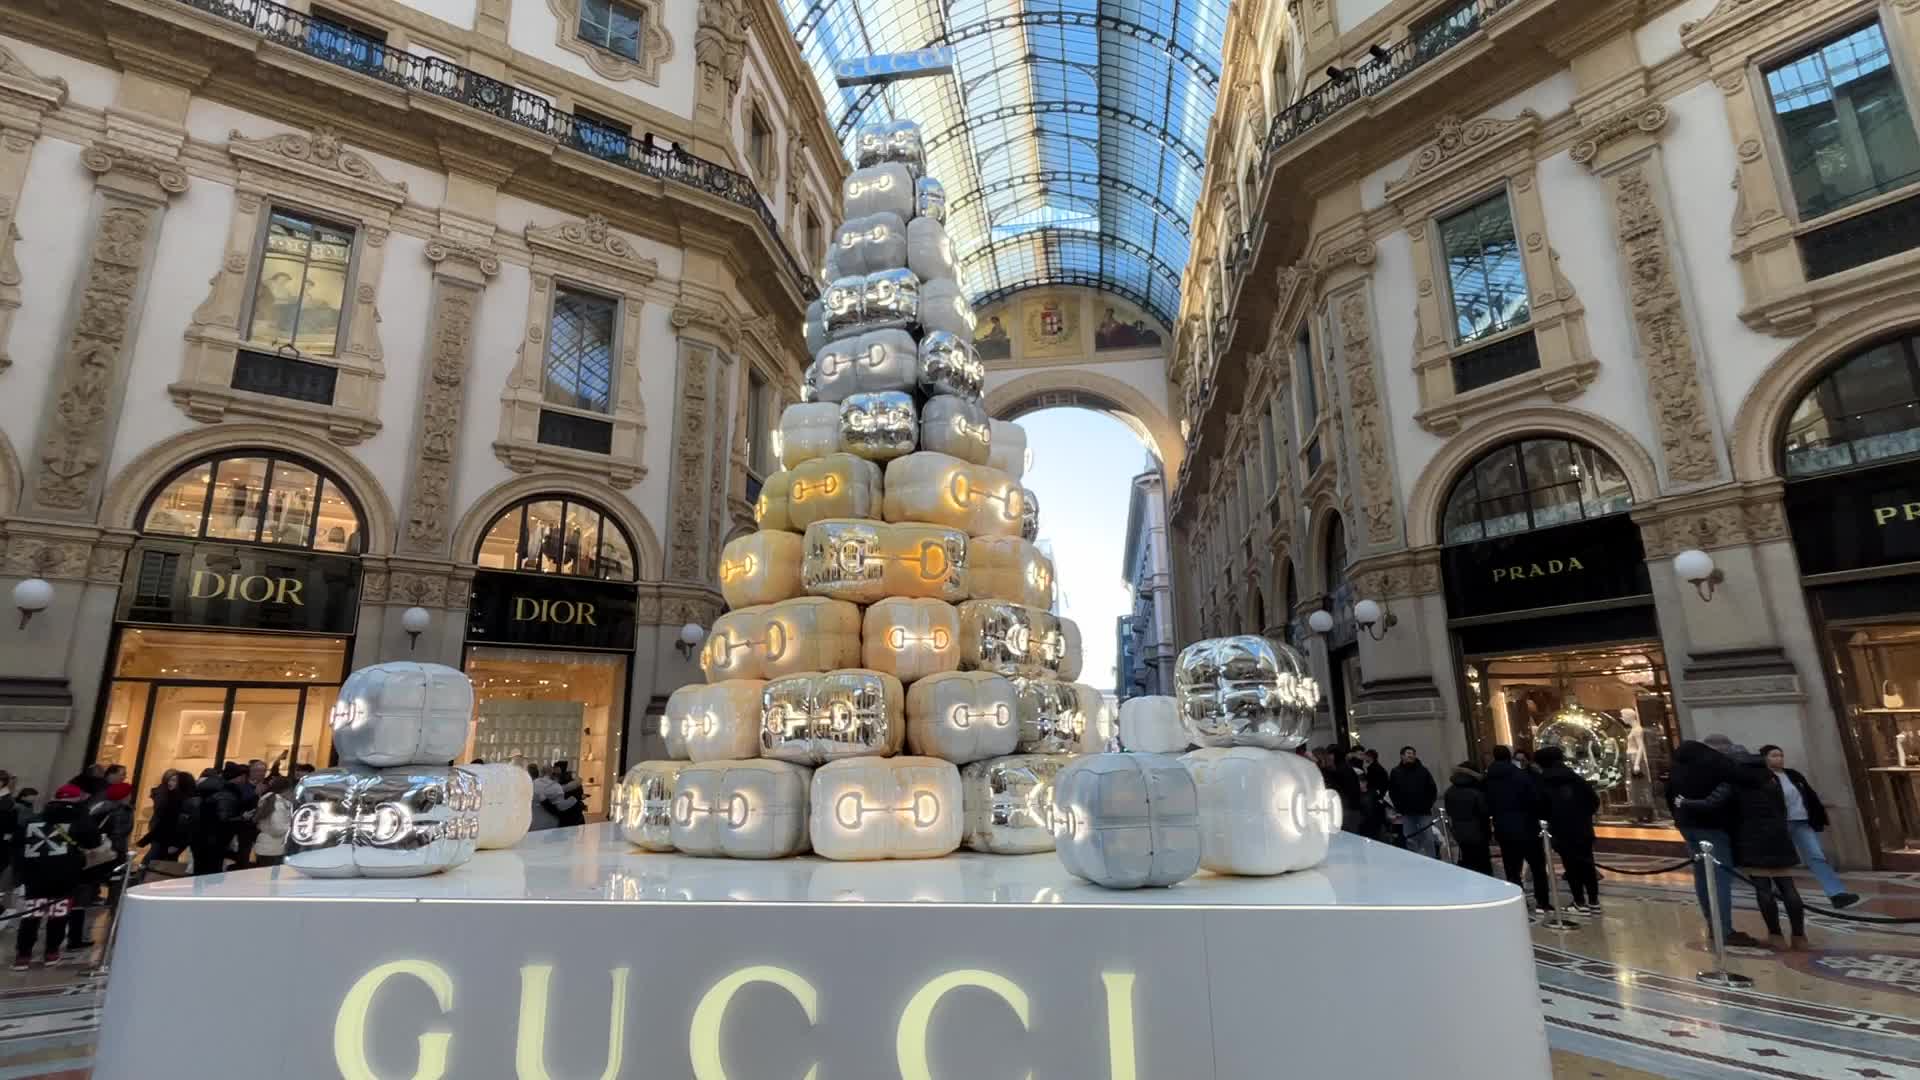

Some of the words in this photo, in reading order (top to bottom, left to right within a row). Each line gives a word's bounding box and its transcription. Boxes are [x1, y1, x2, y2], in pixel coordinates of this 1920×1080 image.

[1492, 557, 1584, 582] PRADA
[189, 570, 305, 606] DIOR
[512, 596, 597, 626] DIOR
[333, 959, 1137, 1080] GUCCI
